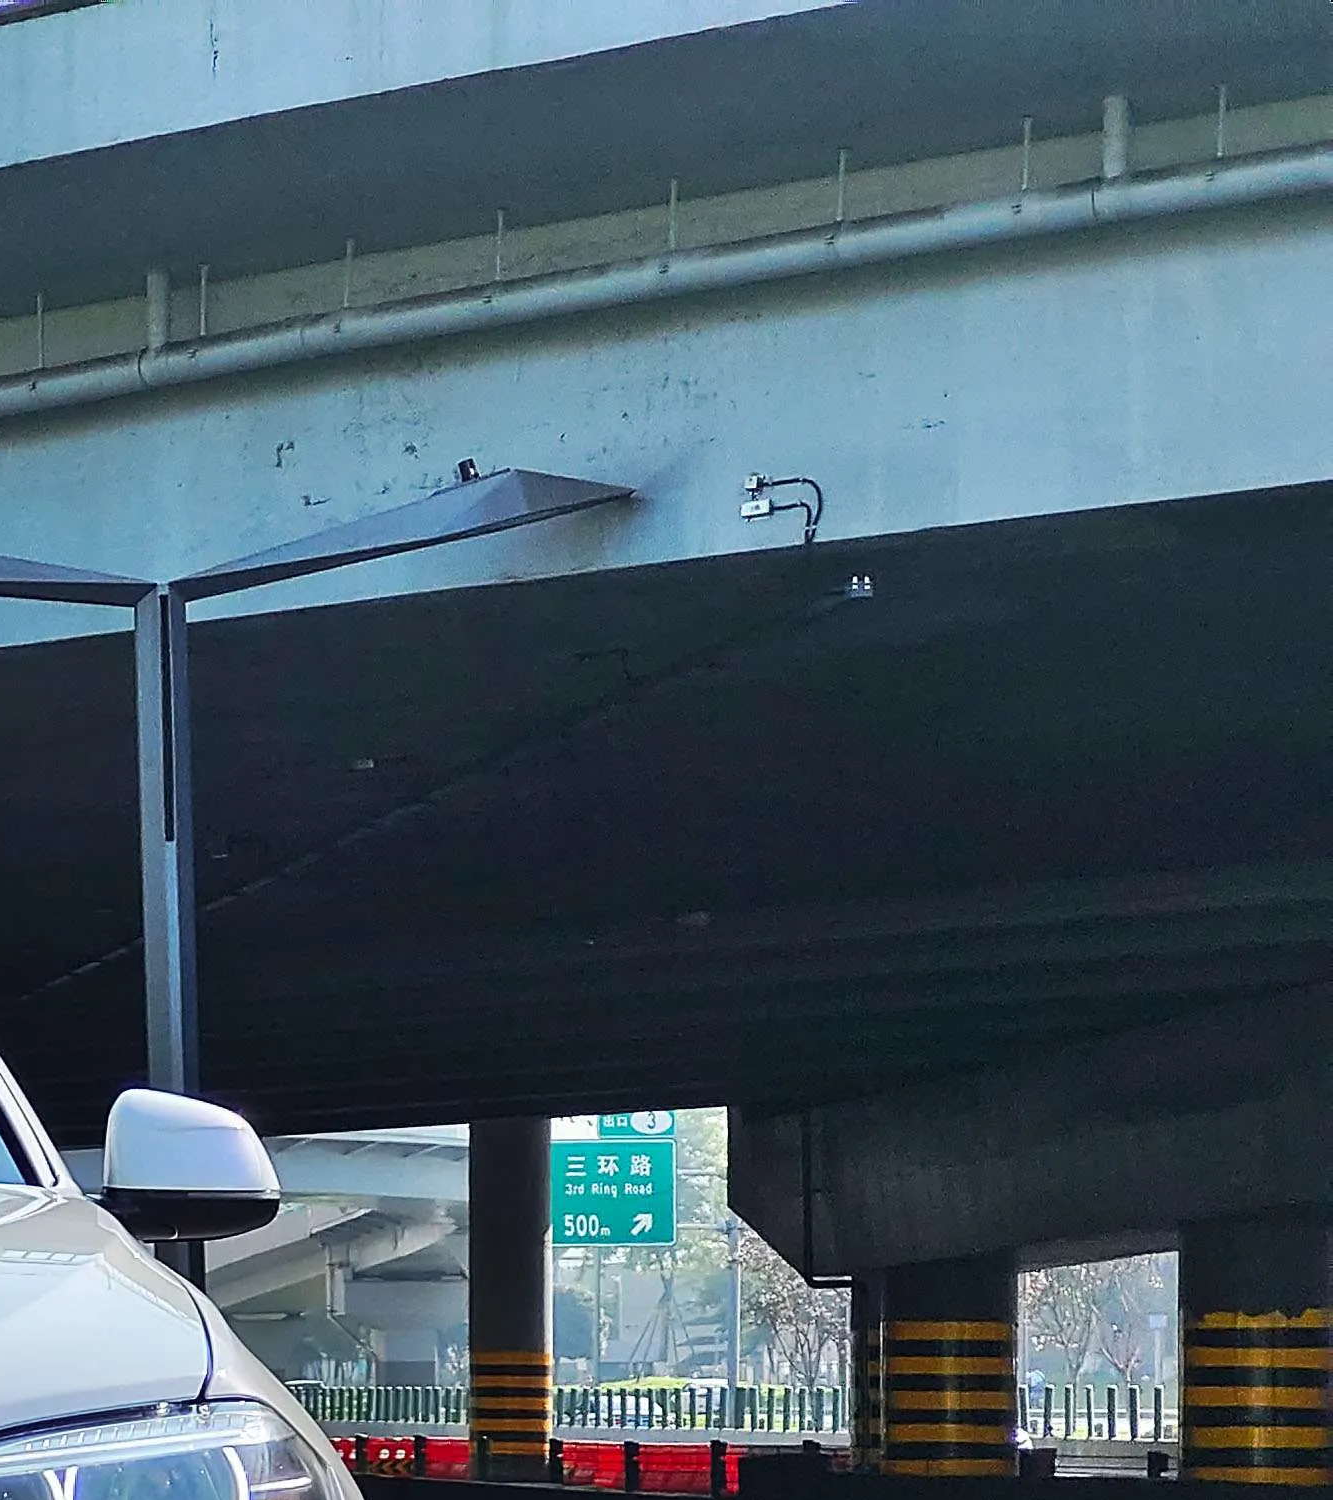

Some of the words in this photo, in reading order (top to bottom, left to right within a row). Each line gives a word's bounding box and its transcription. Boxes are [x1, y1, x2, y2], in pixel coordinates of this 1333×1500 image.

[602, 1116, 629, 1128] 出口
[647, 1113, 656, 1129] 3
[565, 1154, 653, 1177] 三环路
[564, 1183, 585, 1195] 3rd
[591, 1182, 618, 1198] Ring
[624, 1182, 653, 1195] Road
[564, 1214, 611, 1236] 500m
